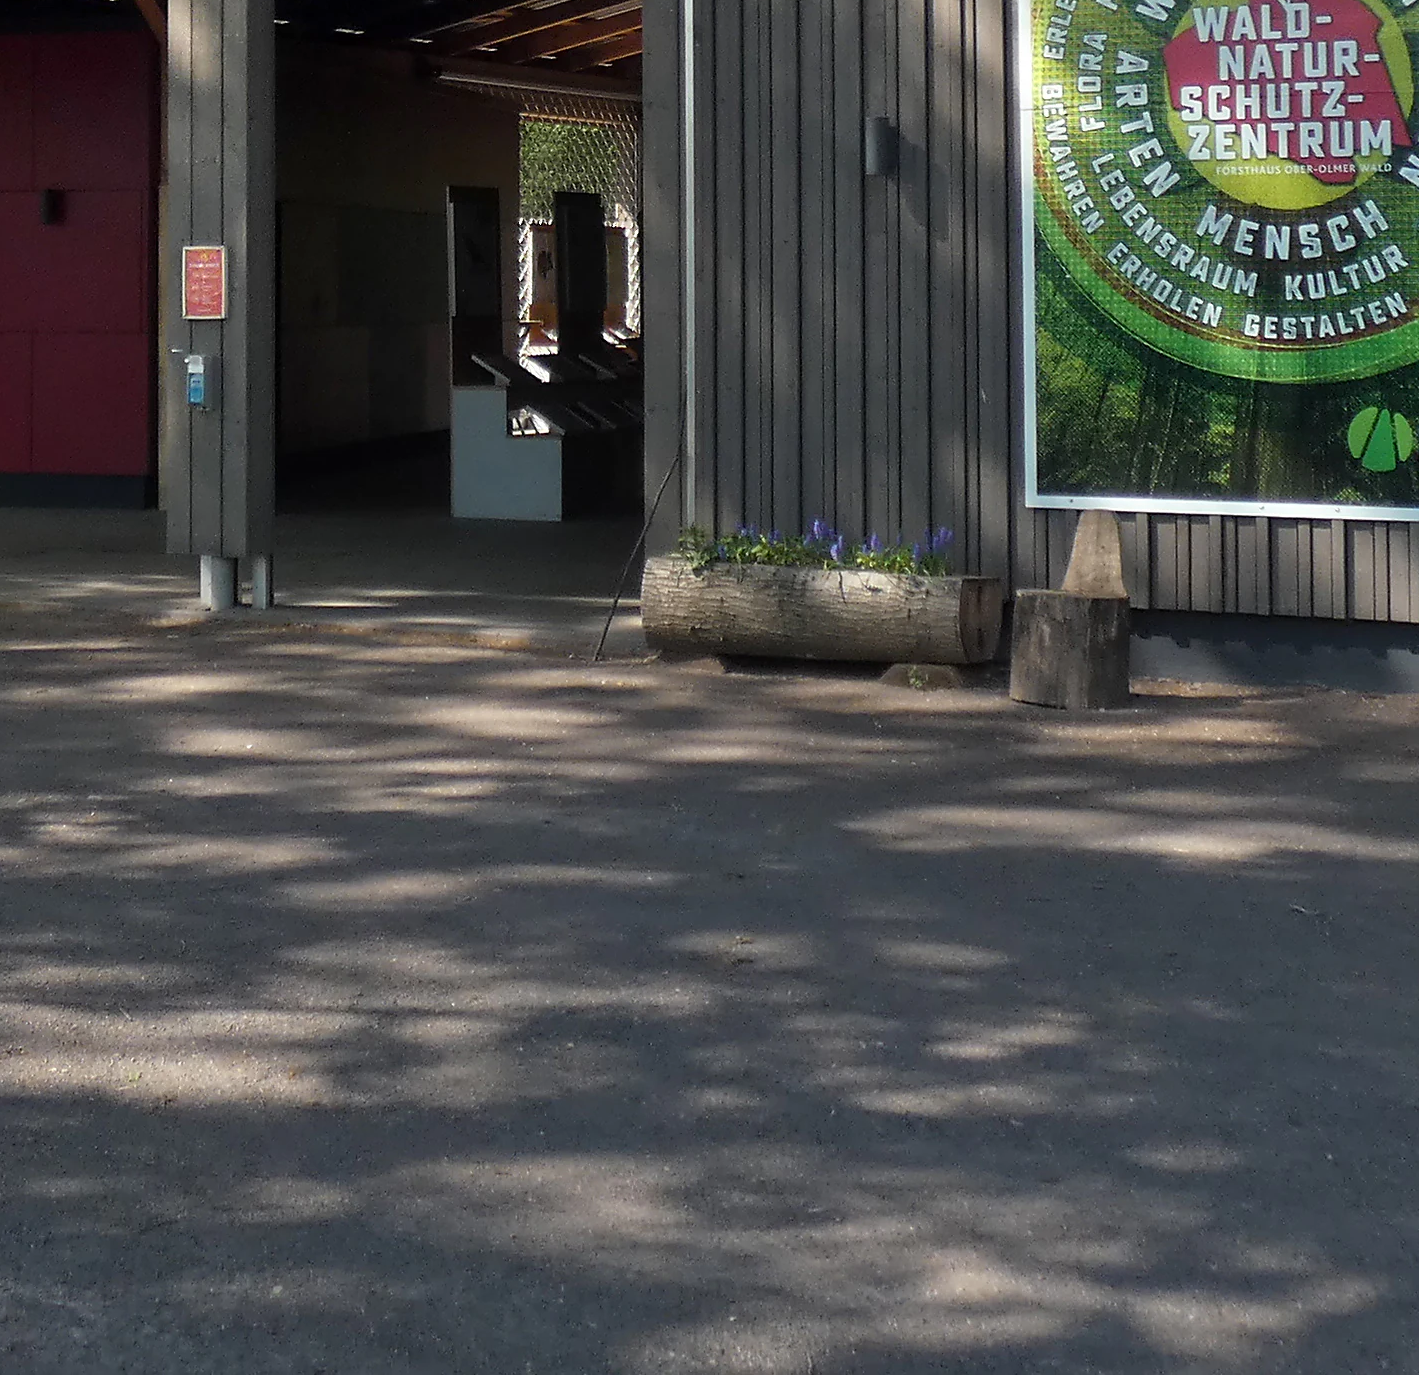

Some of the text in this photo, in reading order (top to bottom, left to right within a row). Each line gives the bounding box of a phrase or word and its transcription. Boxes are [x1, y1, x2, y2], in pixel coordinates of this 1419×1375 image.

[1193, 2, 1332, 43] WALD-
[1078, 32, 1108, 132] FLORA
[1218, 40, 1380, 81] NATUR-
[1115, 50, 1181, 198] ARTEN
[1181, 81, 1364, 122] SCHUTZ-
[1042, 84, 1105, 234] BEWAHREN
[1187, 119, 1393, 161] ZENTRUM
[1216, 162, 1393, 176] FORSTHAUS OBER-OLMER WALD
[1090, 152, 1259, 298] LEBENSRAUM
[1195, 199, 1390, 261] MENSCH
[1106, 241, 1225, 328] ERHOLEN
[1284, 244, 1410, 301] KULTUR
[1243, 291, 1409, 341] GESTALTEN
